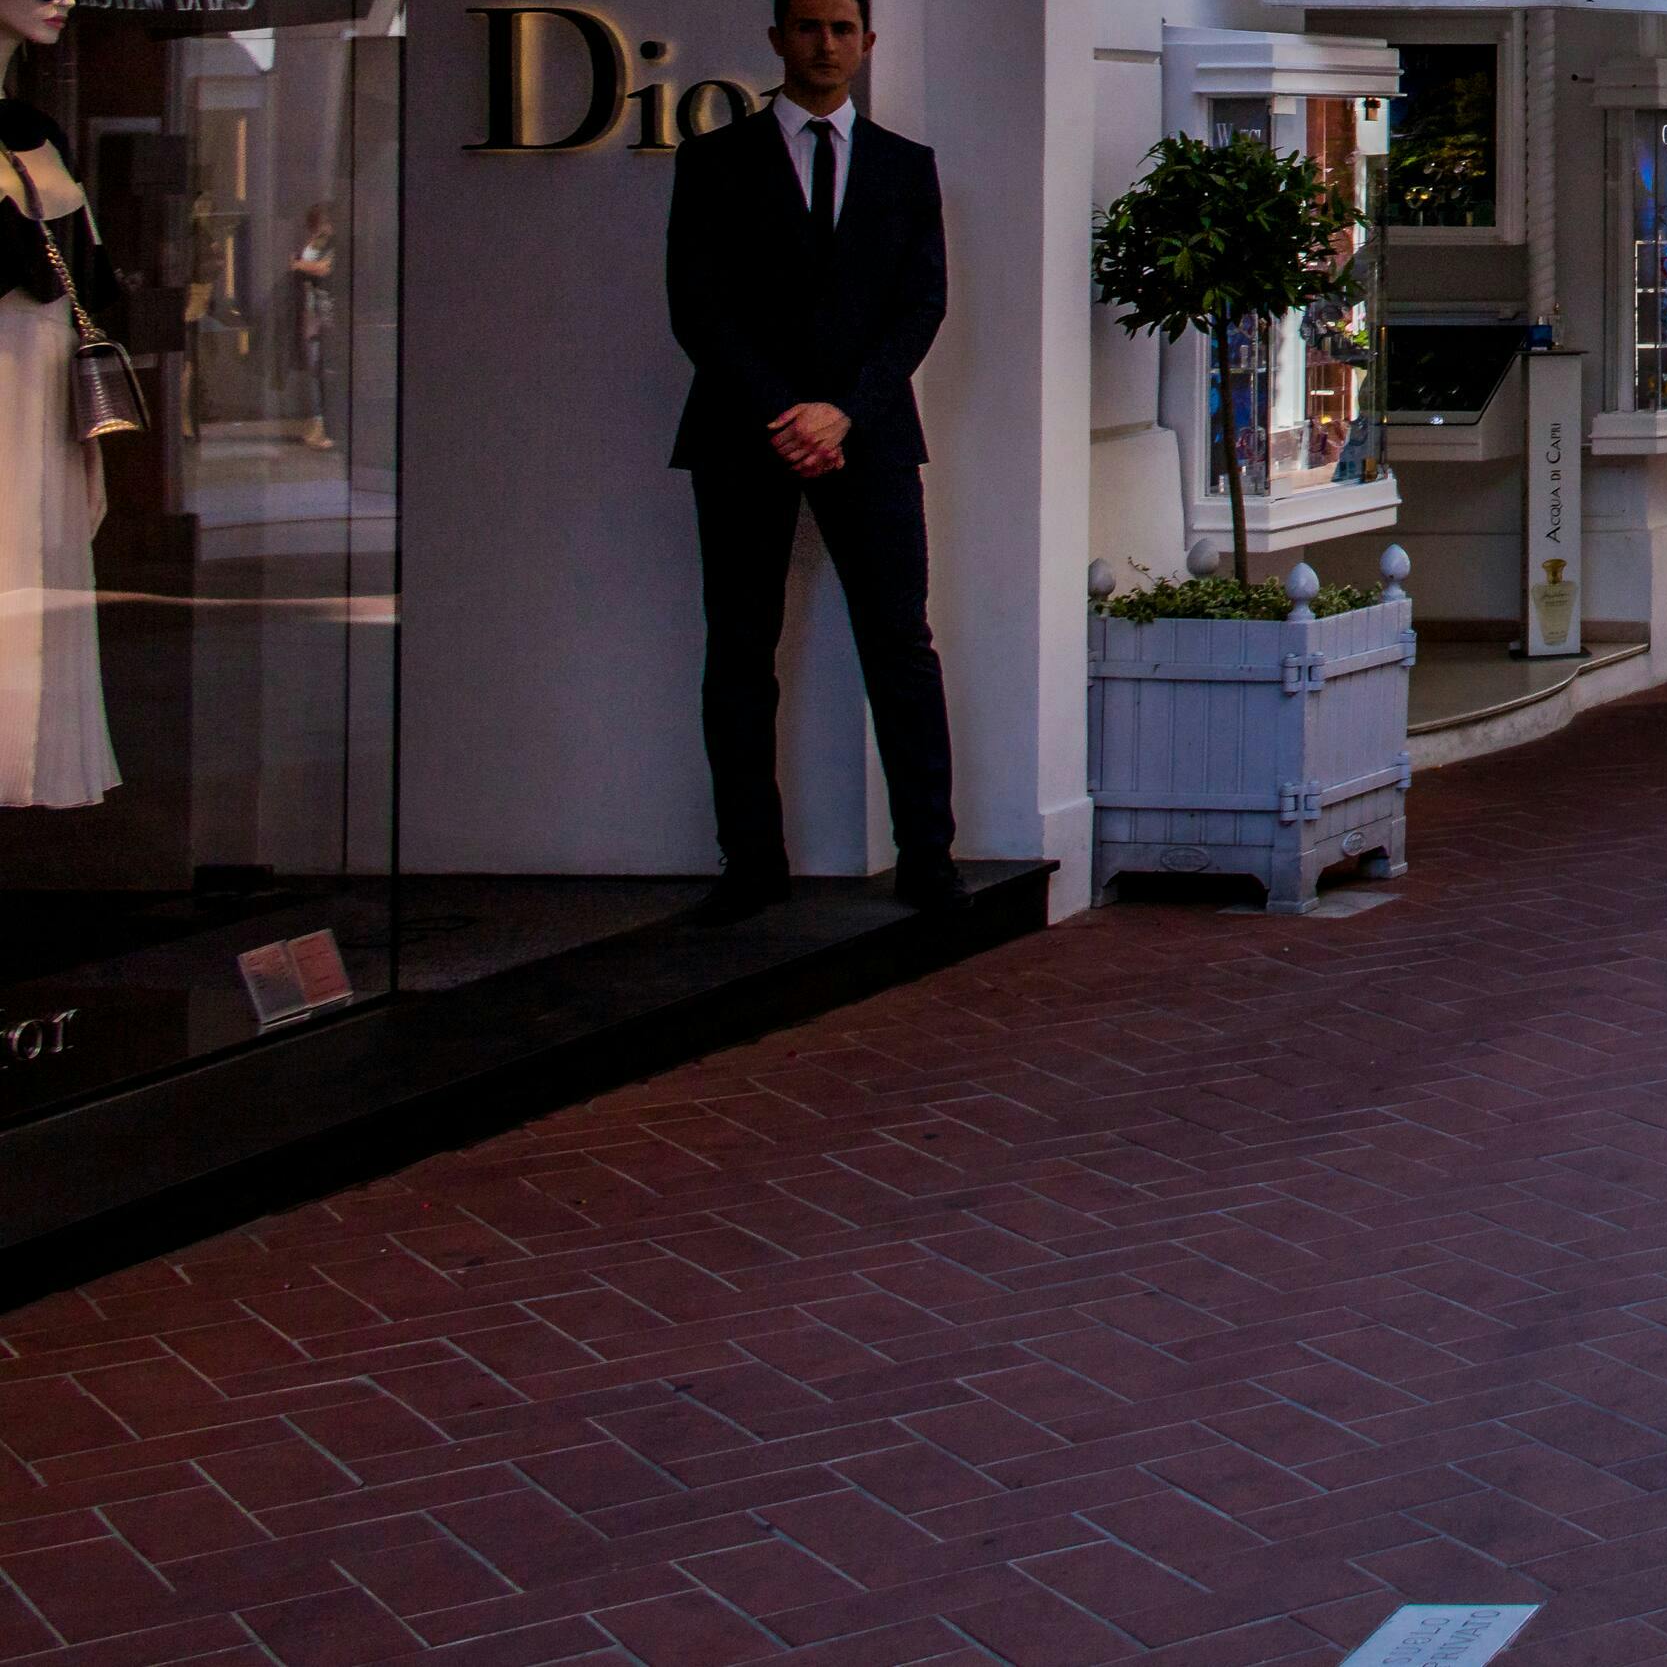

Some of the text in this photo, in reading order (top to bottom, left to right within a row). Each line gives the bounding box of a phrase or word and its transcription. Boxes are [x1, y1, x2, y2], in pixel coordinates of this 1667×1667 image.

[461, 7, 785, 150] Dio
[1545, 422, 1563, 543] ACQUA DI CAPRI
